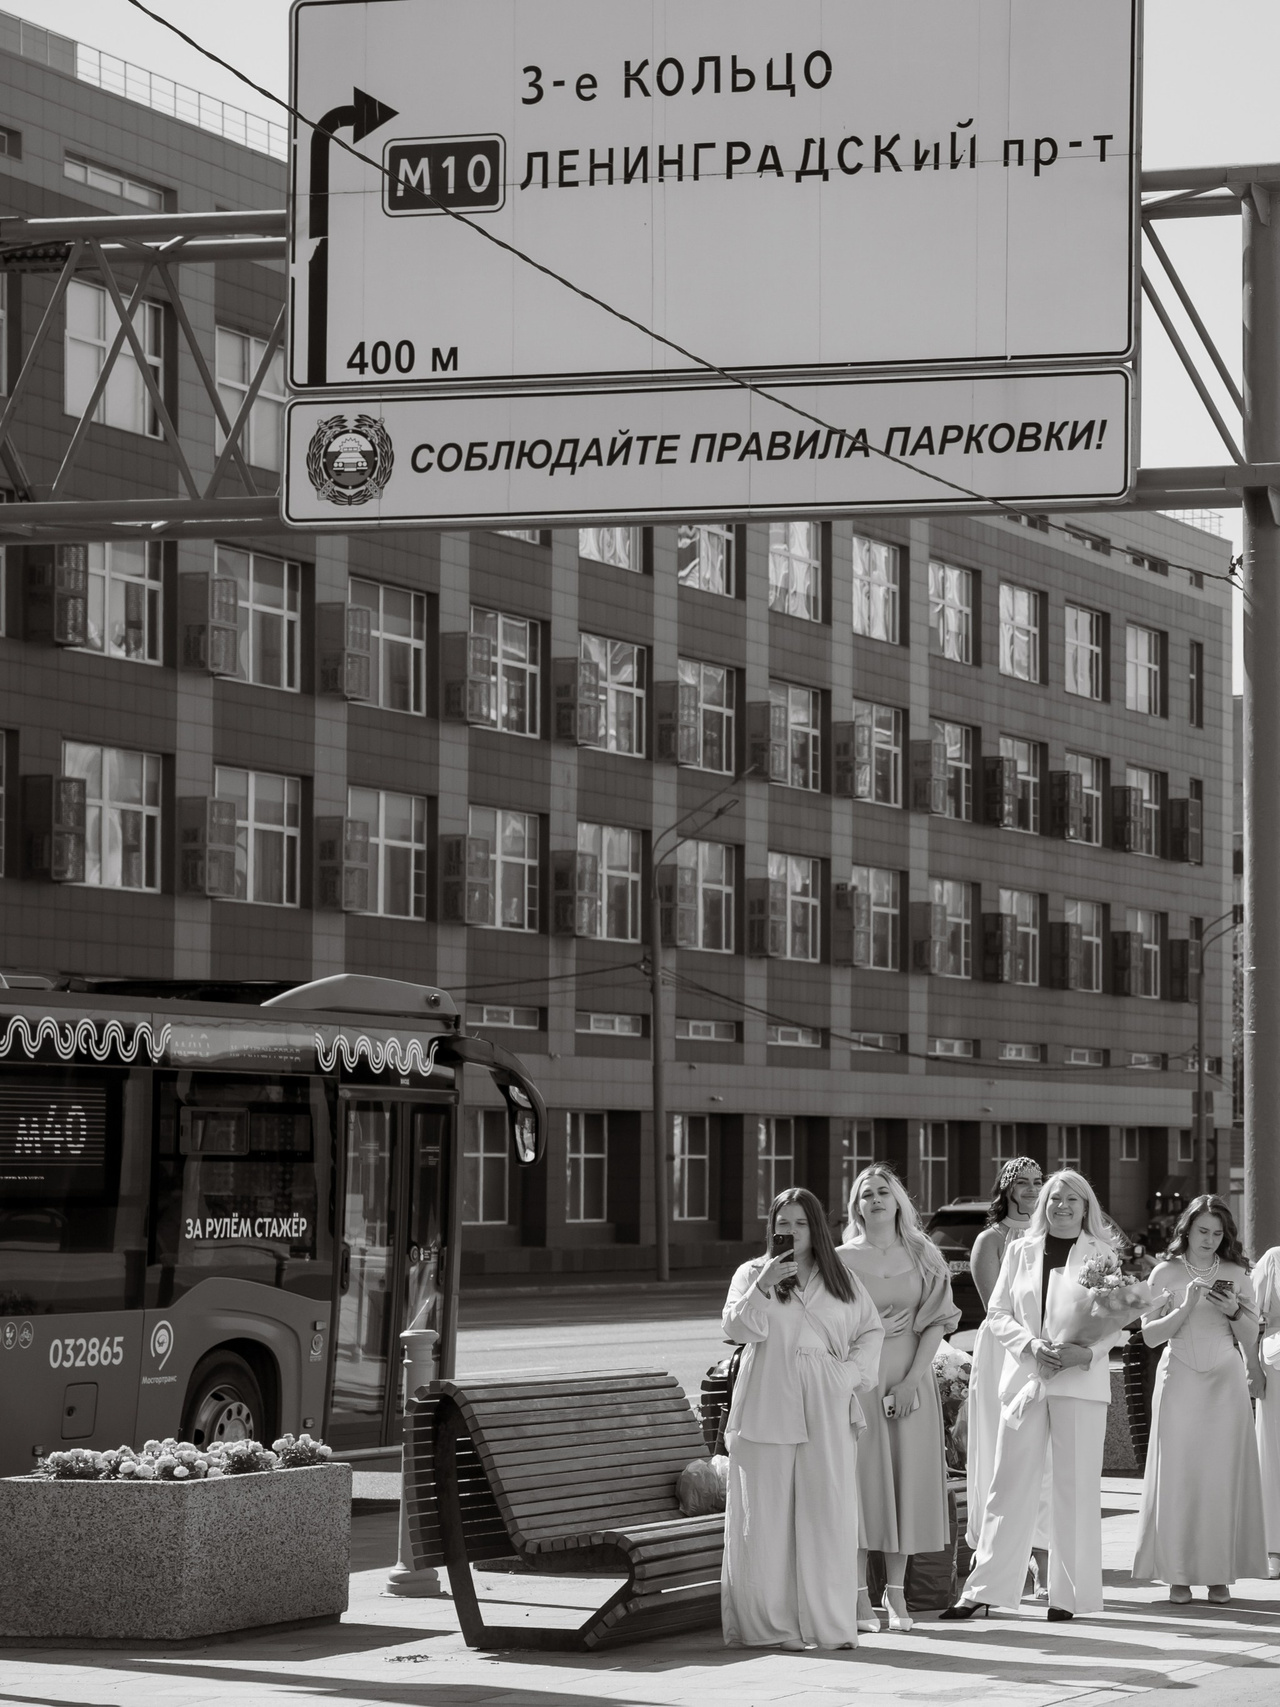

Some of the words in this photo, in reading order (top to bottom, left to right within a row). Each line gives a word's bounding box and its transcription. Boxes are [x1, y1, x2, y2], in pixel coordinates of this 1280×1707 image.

[522, 65, 598, 105] 3-е
[624, 50, 833, 98] КОЛЬЦО
[396, 153, 492, 197] М10
[1003, 134, 1114, 177] пр-т
[346, 339, 416, 375] 400
[431, 346, 458, 372] м
[411, 428, 681, 476] СОБЛЮДАЙТЕ
[690, 427, 872, 464] ПРАВИЛА
[884, 419, 1108, 458] ПАРКОВКИ!
[185, 1218, 203, 1239] ЗА
[205, 1212, 252, 1239] РУЛЁМ
[254, 1212, 308, 1238] СТАЖЁР
[49, 1336, 125, 1369] 032865
[141, 1375, 178, 1386] Мосгортранс
